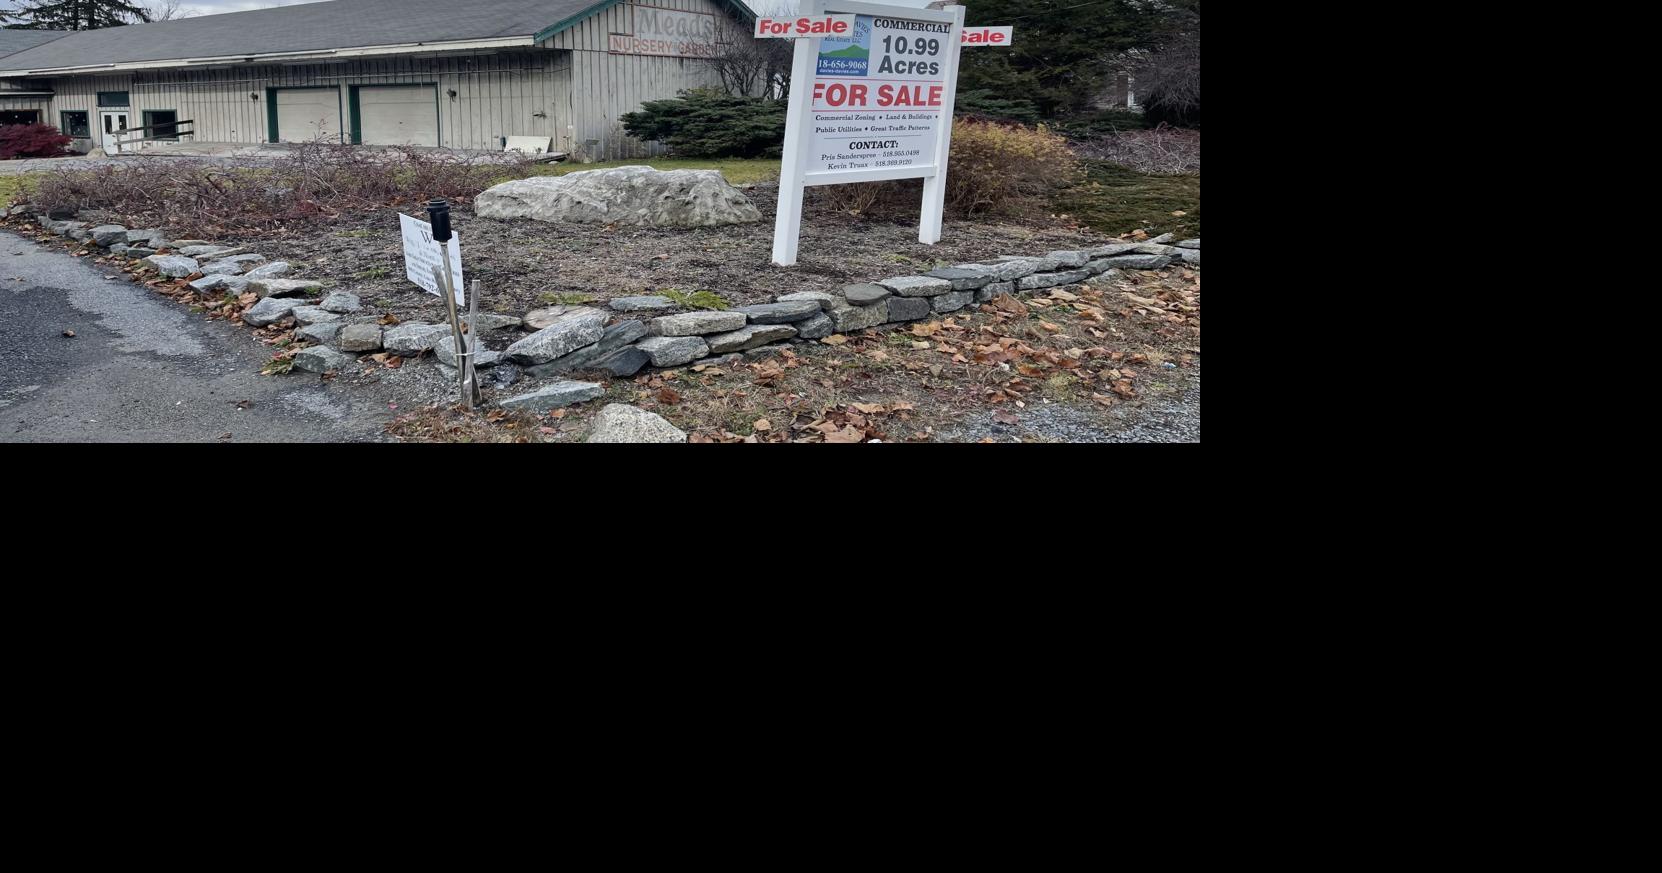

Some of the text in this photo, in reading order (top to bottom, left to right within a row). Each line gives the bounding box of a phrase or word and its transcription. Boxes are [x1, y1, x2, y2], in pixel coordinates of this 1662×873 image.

[759, 19, 792, 35] For
[795, 17, 848, 34] Sale
[873, 18, 951, 34] COMMERCIAL
[612, 36, 672, 53] NURSERY
[882, 35, 940, 56] 10.99
[818, 59, 867, 70] 18-656-9068
[878, 55, 940, 75] Acres
[812, 83, 944, 107] FOR SALE
[848, 140, 899, 150] CONTACT:
[821, 153, 836, 161] Pris
[827, 162, 847, 170] Kevin
